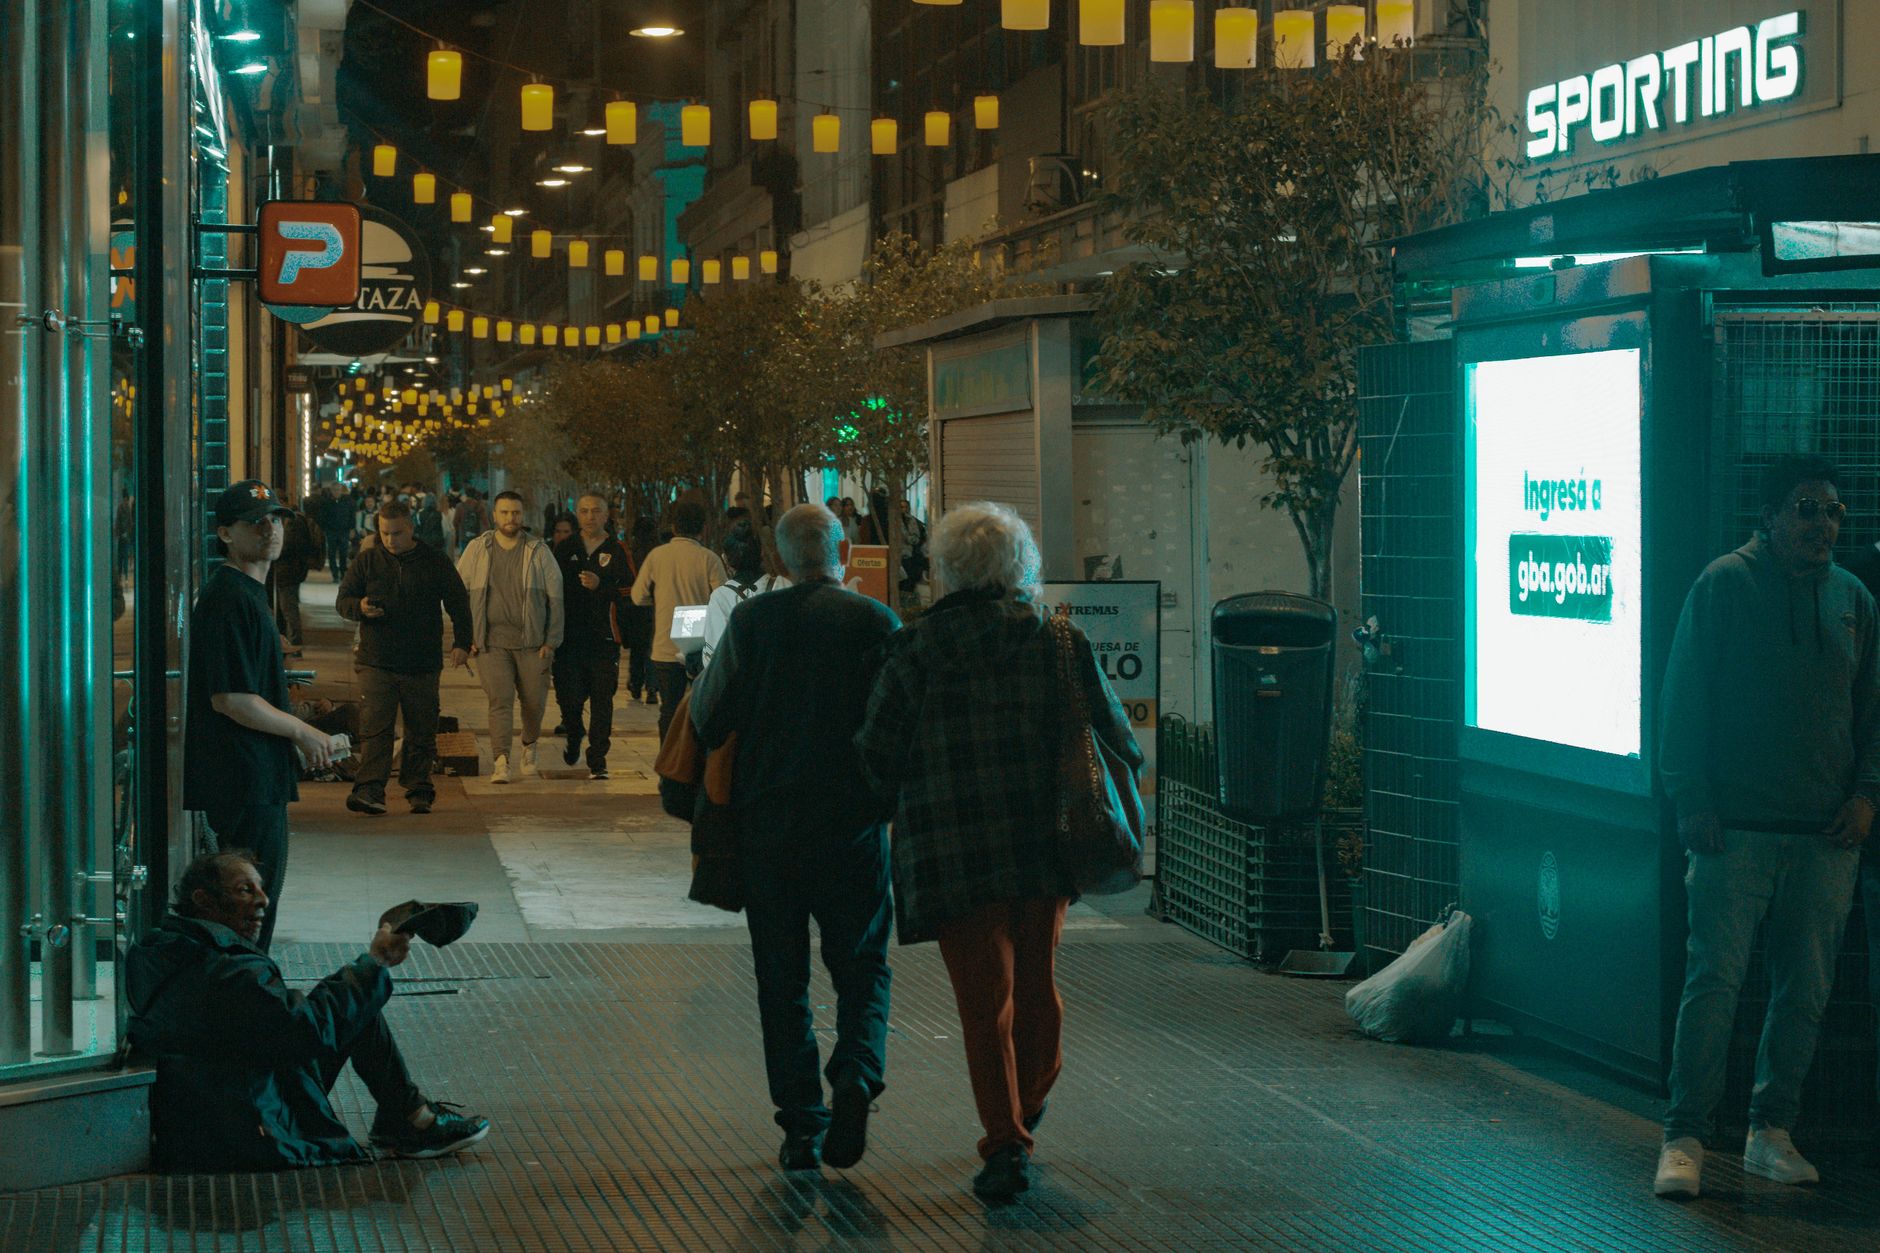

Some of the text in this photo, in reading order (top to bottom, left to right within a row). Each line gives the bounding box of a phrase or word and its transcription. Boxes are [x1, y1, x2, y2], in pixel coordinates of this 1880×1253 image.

[1526, 11, 1799, 158] SPORTING
[278, 221, 344, 285] P
[340, 287, 422, 310] TAZA
[1524, 466, 1601, 521] Ingresá a
[1518, 550, 1610, 605] gba.gob.ar
[1101, 653, 1142, 680] LO
[1124, 642, 1139, 652] DE
